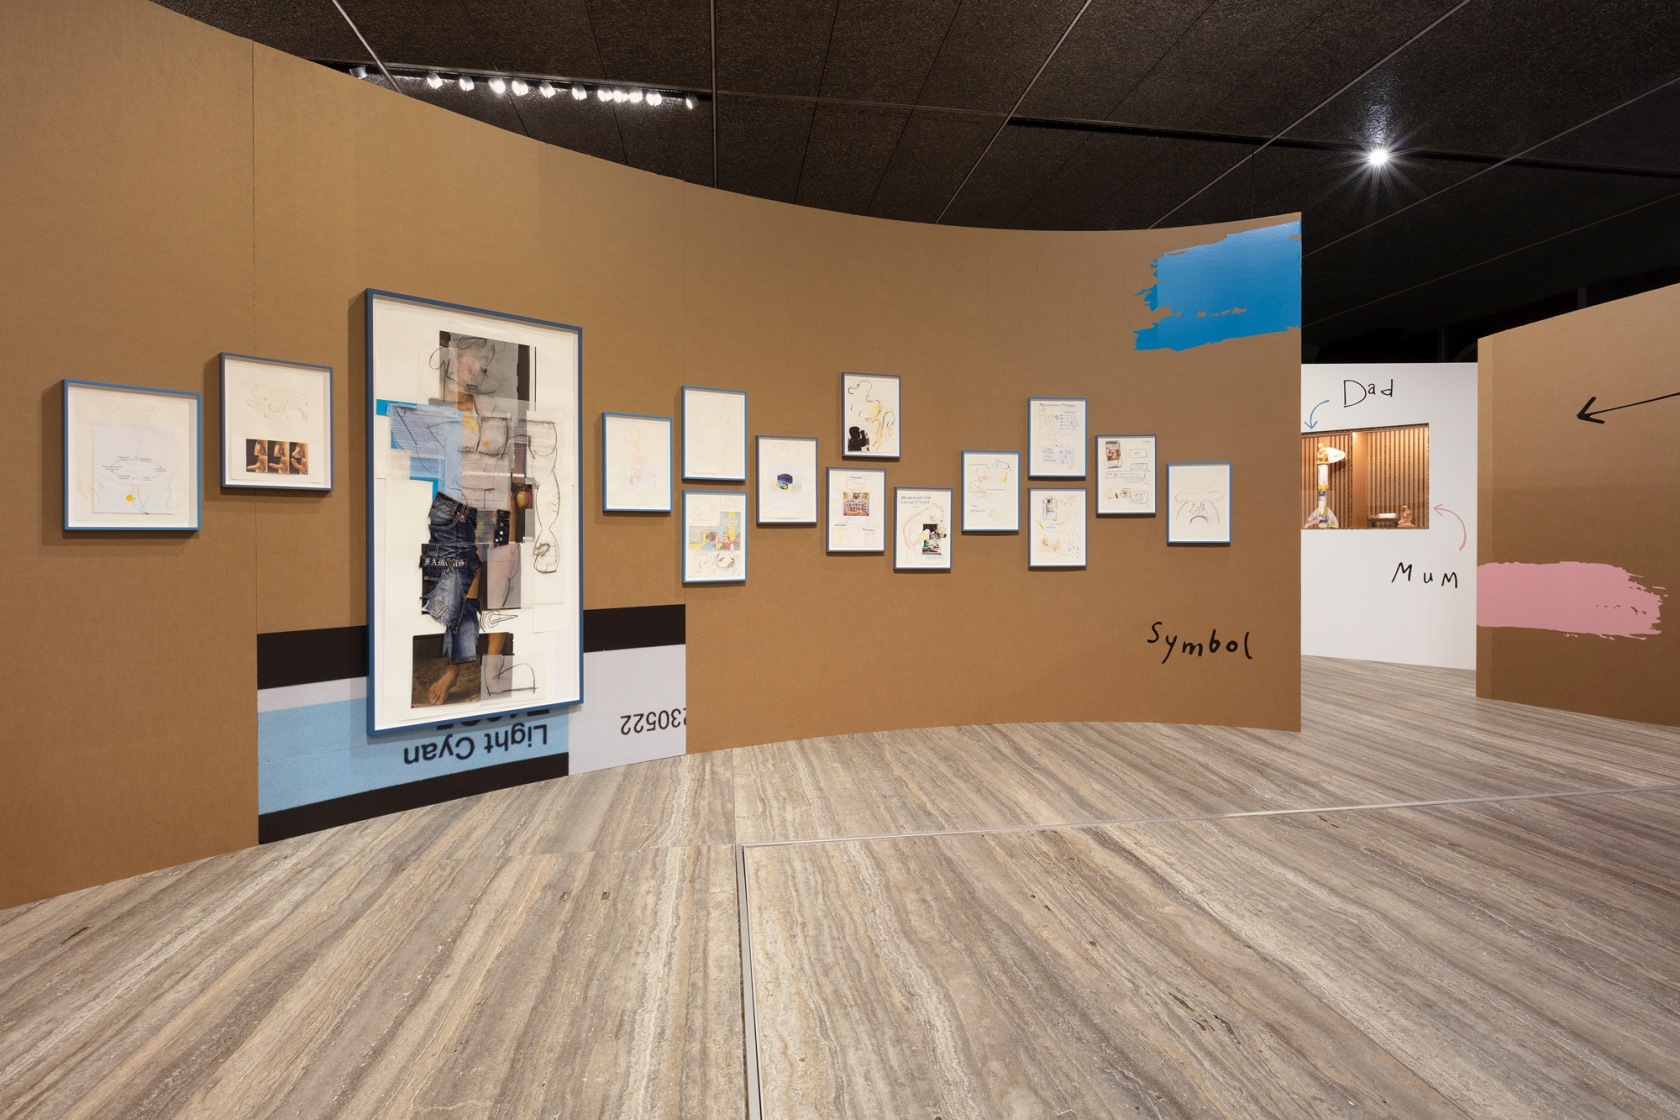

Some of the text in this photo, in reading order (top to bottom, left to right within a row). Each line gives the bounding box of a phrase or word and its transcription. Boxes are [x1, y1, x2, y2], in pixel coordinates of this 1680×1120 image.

[1343, 379, 1394, 408] Dad
[1146, 621, 1253, 664] Symbol
[403, 734, 476, 765] Cyan
[484, 722, 548, 754] Light
